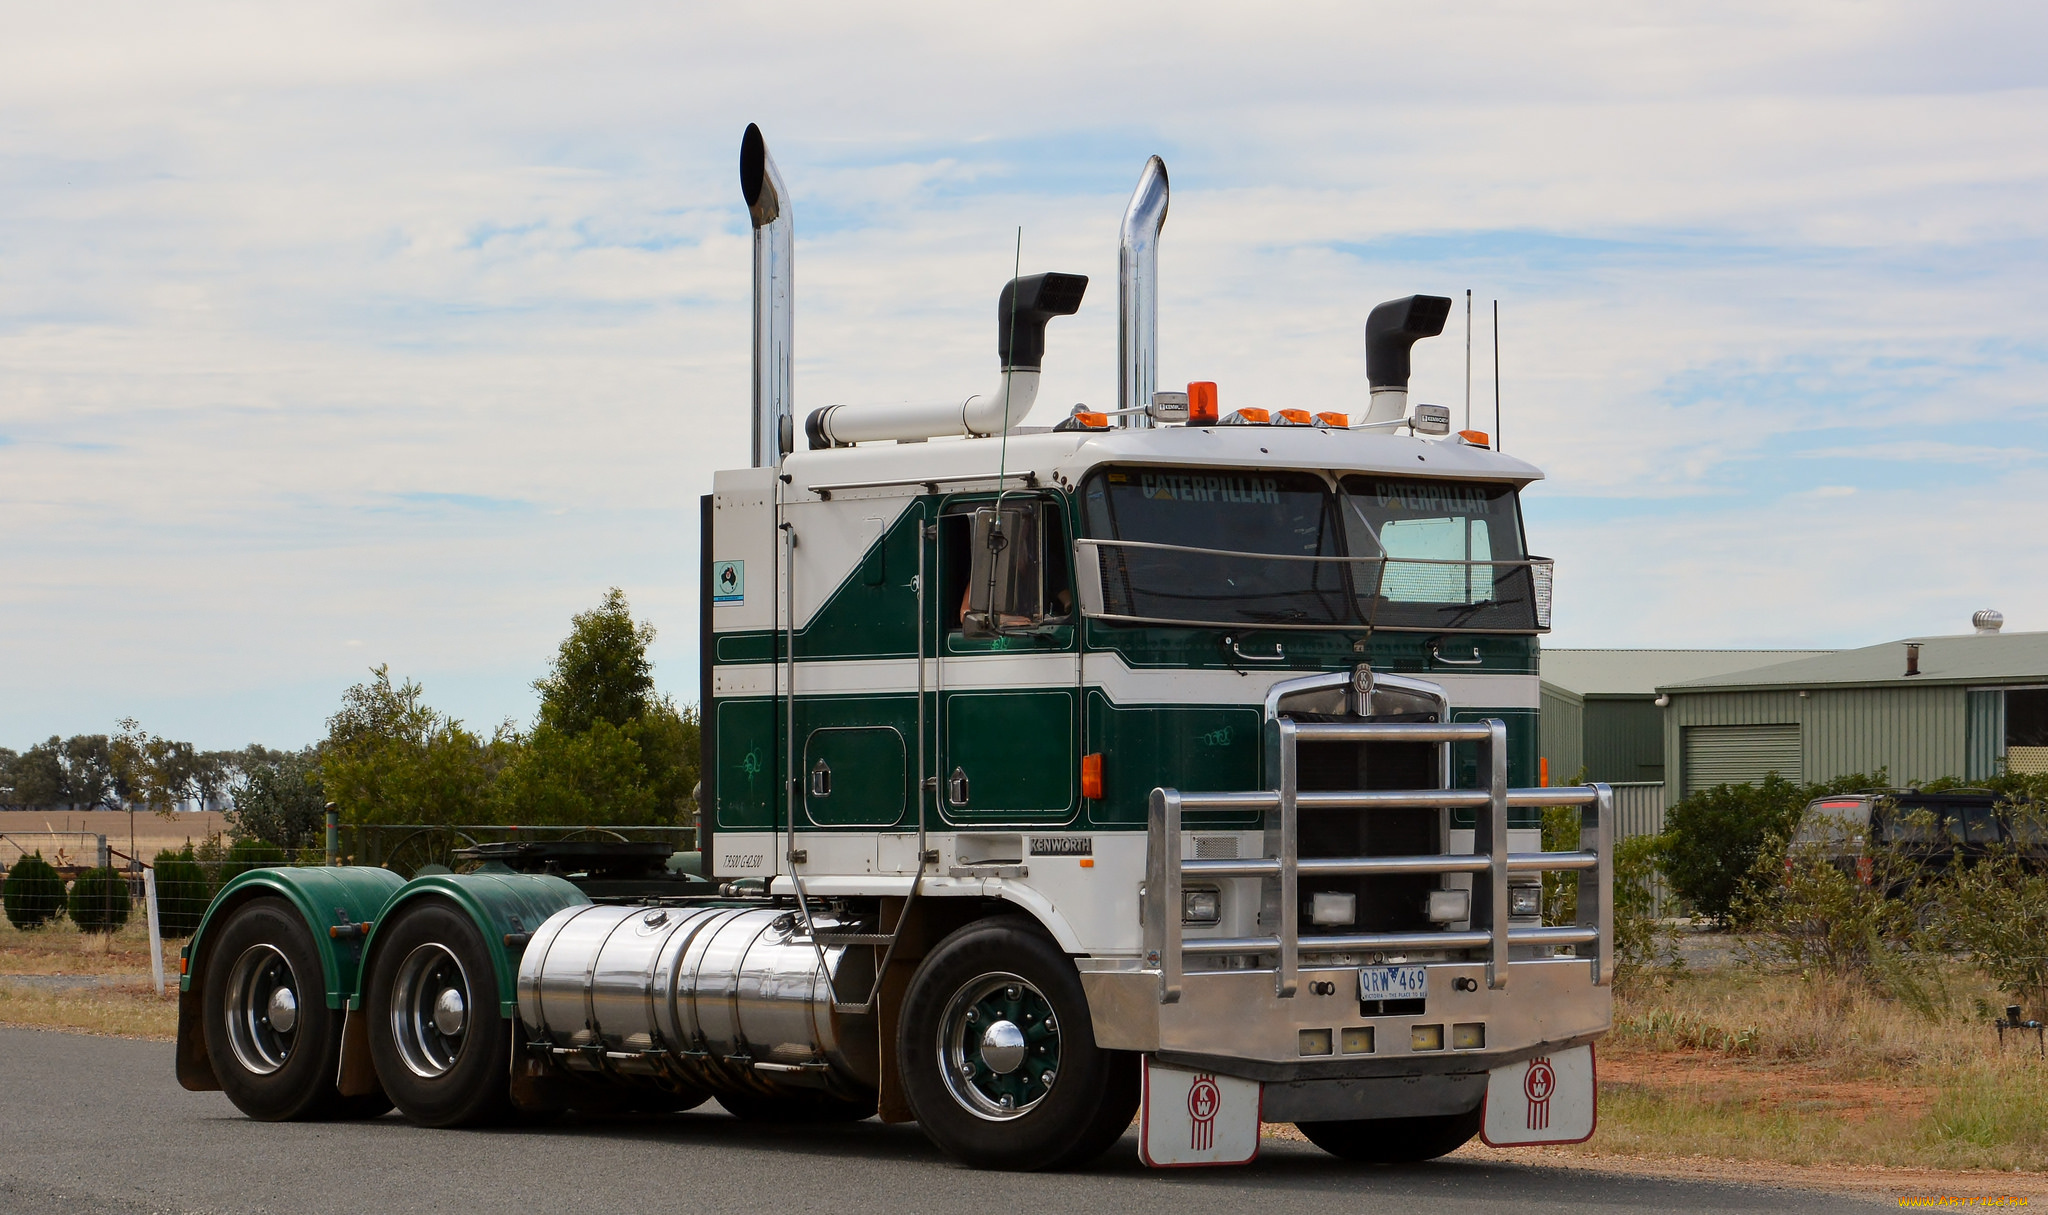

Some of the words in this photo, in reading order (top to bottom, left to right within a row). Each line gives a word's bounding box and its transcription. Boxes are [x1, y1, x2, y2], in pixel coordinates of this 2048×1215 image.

[1141, 473, 1281, 505] CATERPILLAR
[1376, 483, 1490, 514] CATERPILLAR
[1031, 837, 1091, 852] KENWORTH
[1363, 971, 1389, 992] QRW
[1399, 970, 1424, 990] 469
